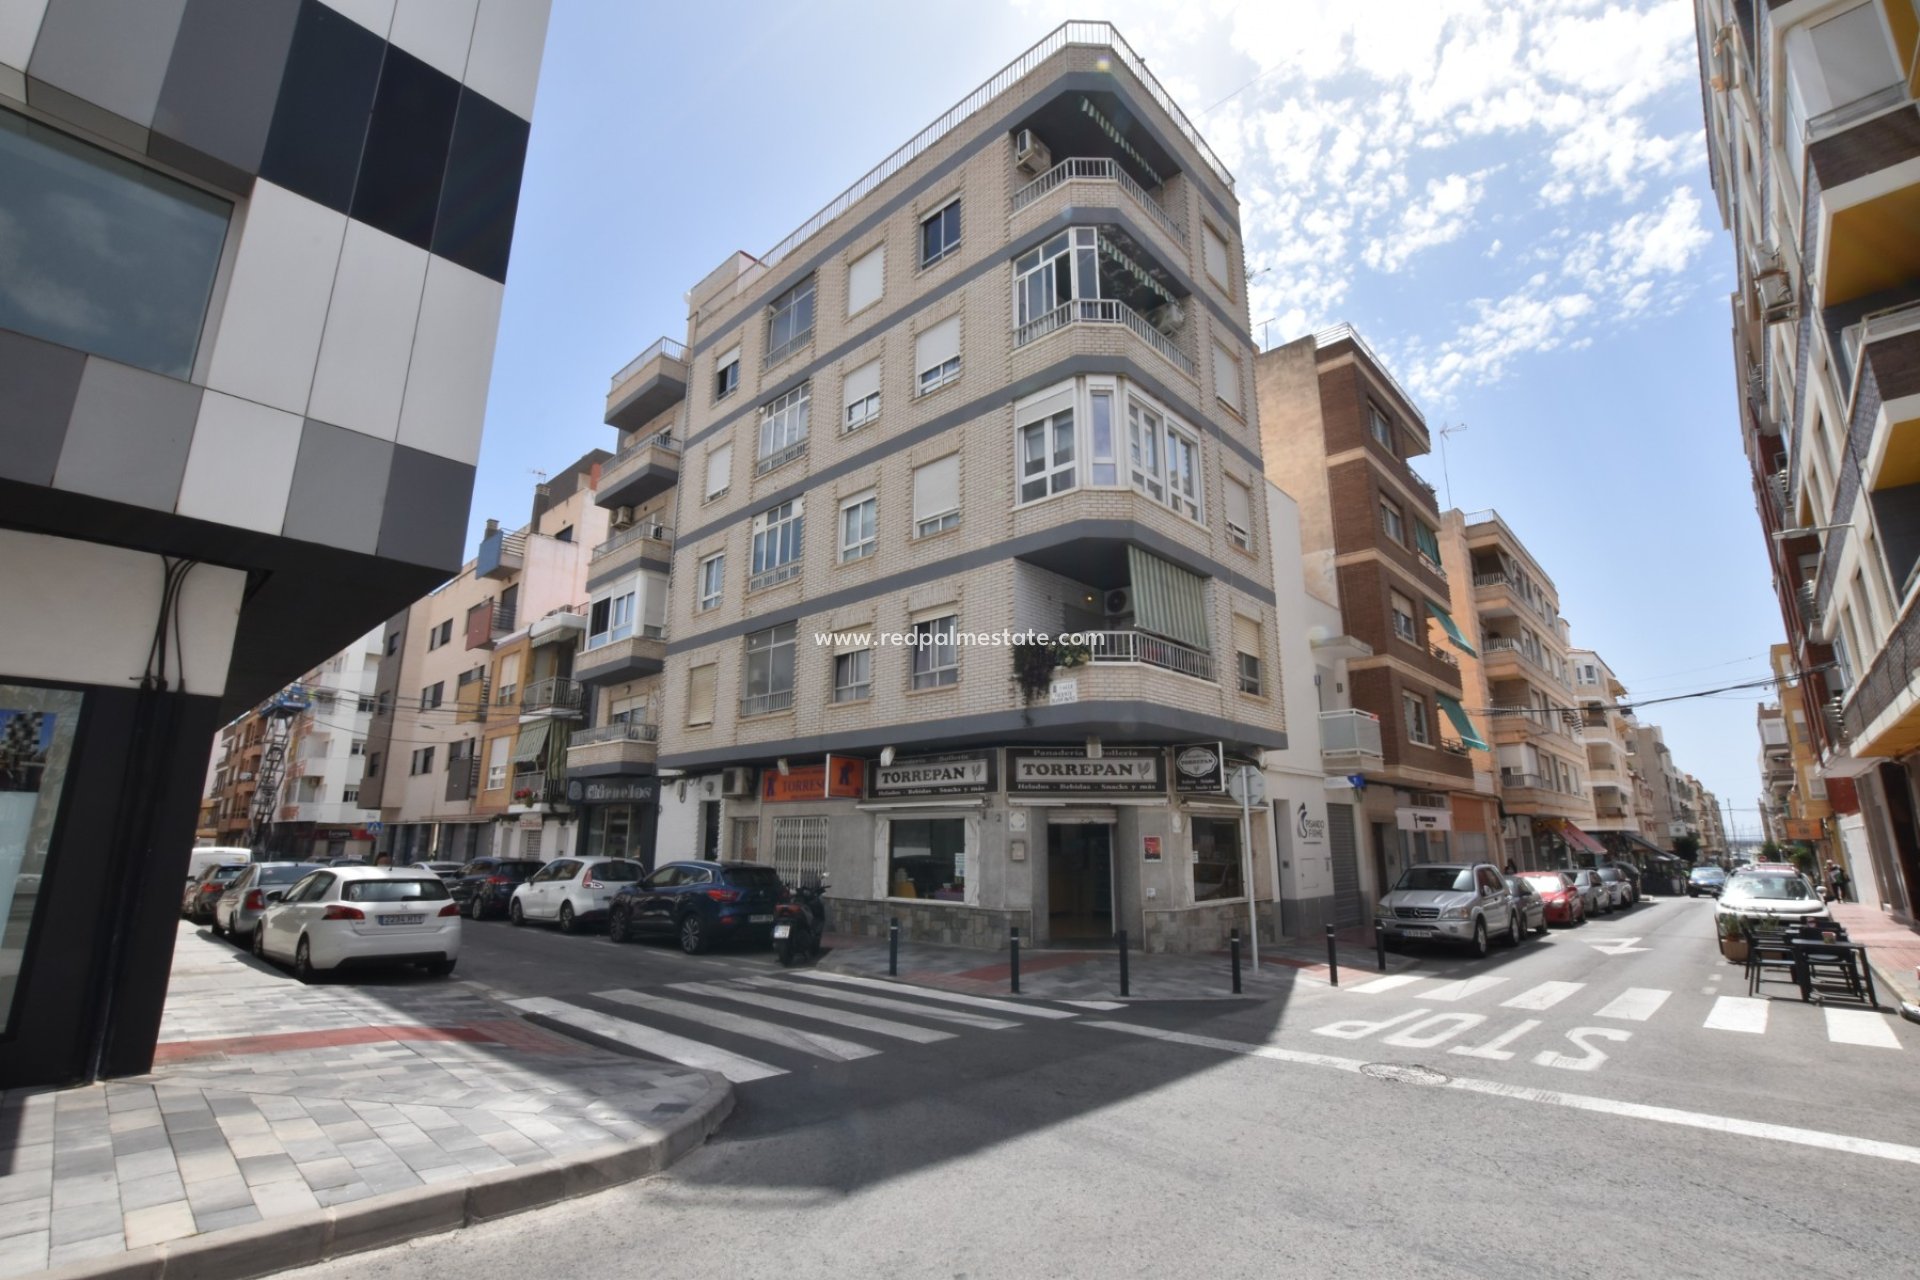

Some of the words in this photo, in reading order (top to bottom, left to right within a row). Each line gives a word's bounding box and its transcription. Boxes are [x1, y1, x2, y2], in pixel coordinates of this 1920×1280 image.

[881, 767, 965, 784] TORREPAN
[1022, 763, 1133, 776] TORREPAN
[1311, 1008, 1633, 1071] STOP
